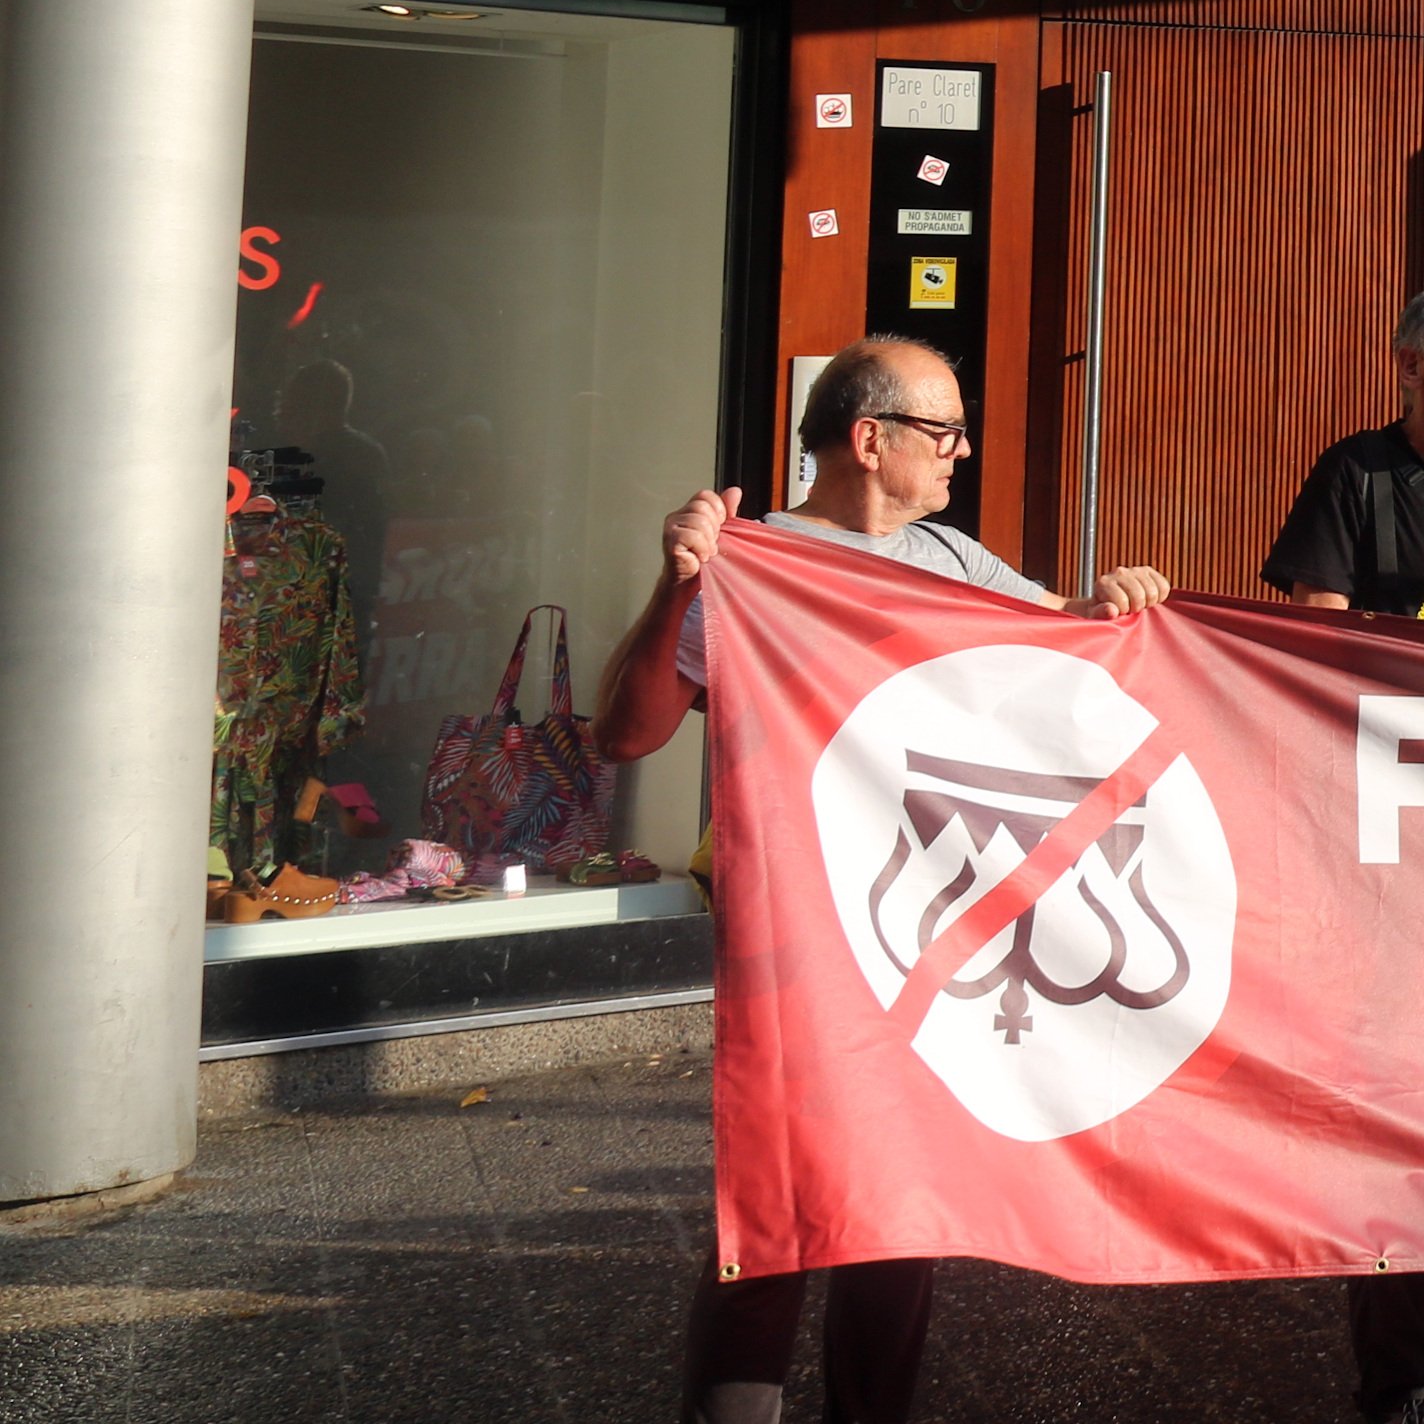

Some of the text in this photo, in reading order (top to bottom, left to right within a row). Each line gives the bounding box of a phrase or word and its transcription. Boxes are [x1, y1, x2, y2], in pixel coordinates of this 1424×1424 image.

[888, 71, 977, 97] Pare Claret
[937, 103, 955, 125] 10
[907, 211, 921, 221] NO
[904, 222, 965, 232] PROPAGANDA
